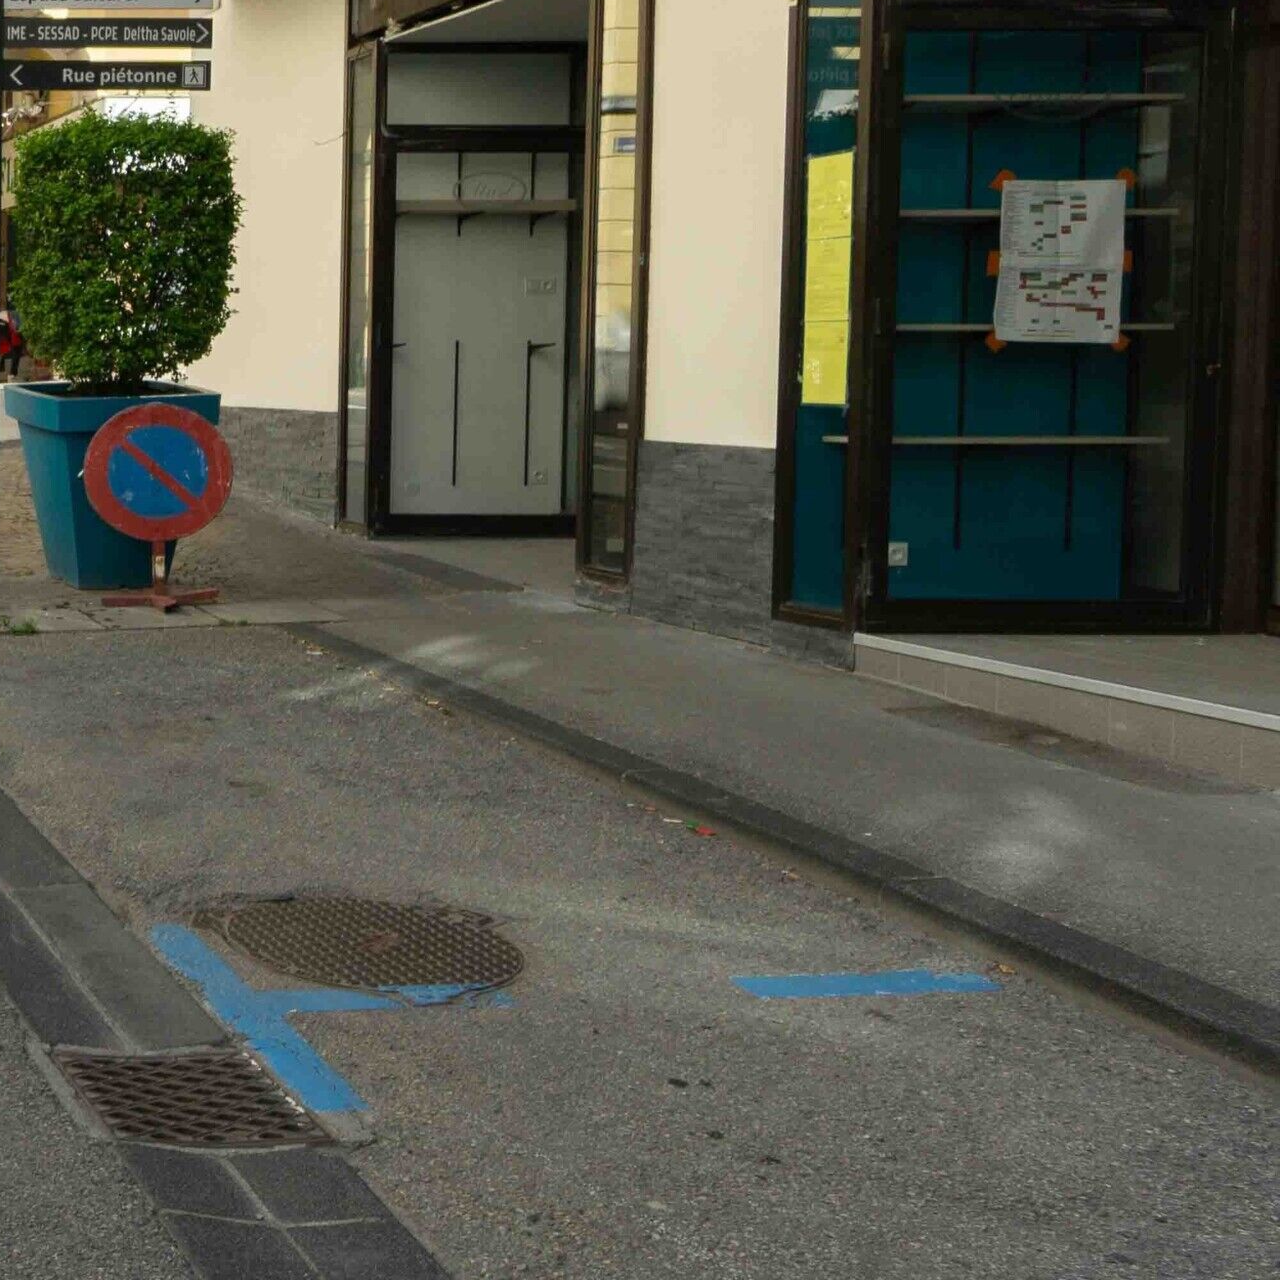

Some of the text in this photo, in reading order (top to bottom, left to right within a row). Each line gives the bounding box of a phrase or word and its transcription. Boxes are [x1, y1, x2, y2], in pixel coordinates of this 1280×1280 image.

[7, 25, 26, 40] IME
[38, 25, 80, 40] SESSAD
[91, 25, 119, 40] PCPE
[123, 25, 159, 41] Deltha
[62, 67, 177, 86] Rue piétonne
